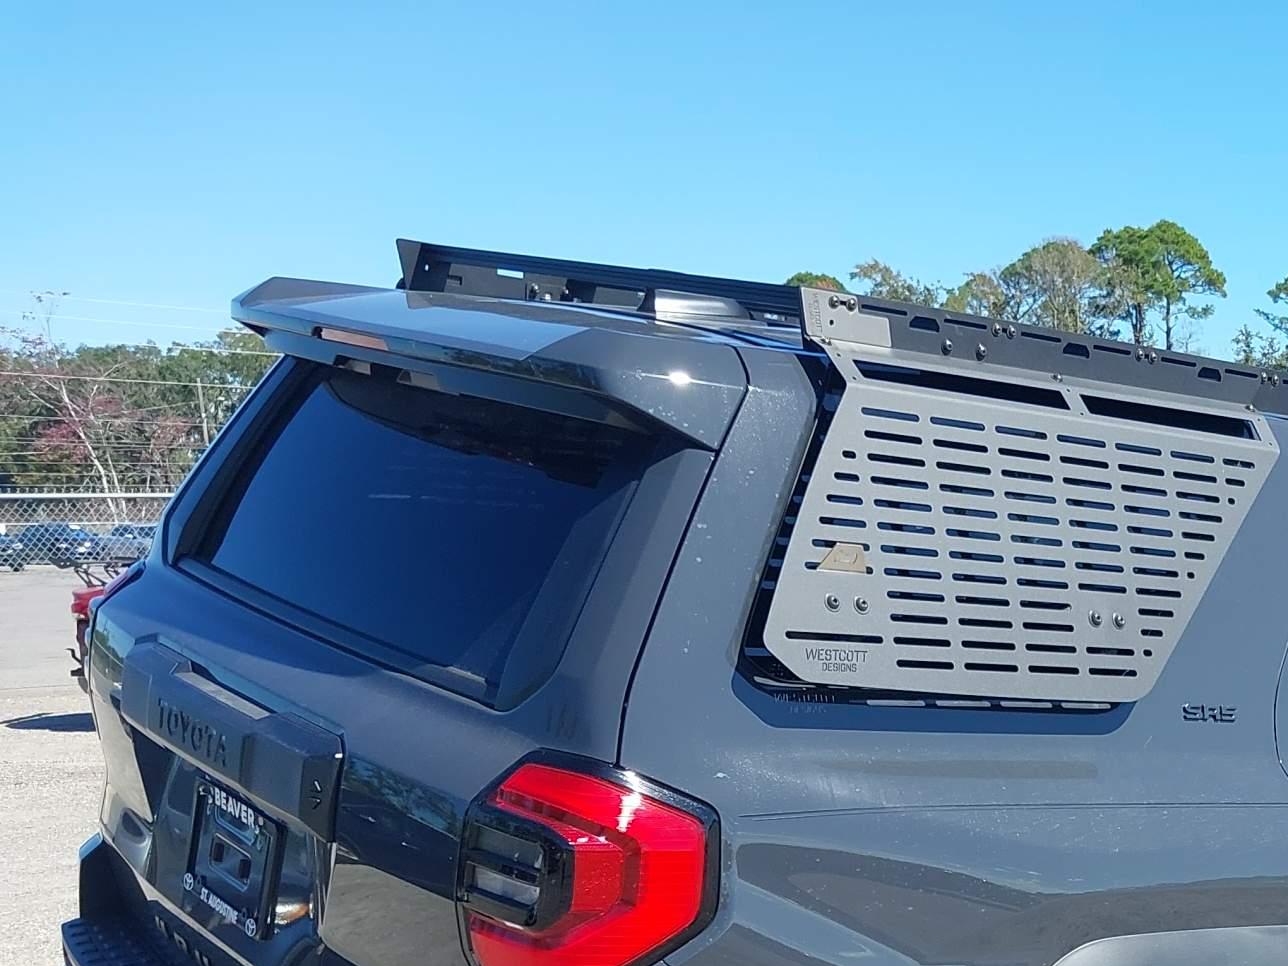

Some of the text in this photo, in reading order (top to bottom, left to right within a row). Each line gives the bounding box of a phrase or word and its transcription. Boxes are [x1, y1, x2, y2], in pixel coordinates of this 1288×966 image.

[804, 647, 868, 663] WESTCOTT
[821, 662, 858, 673] DESIGNS
[158, 696, 227, 768] TOYOTA
[213, 786, 256, 832] BEAVER
[208, 891, 239, 925] AUGUSTINE
